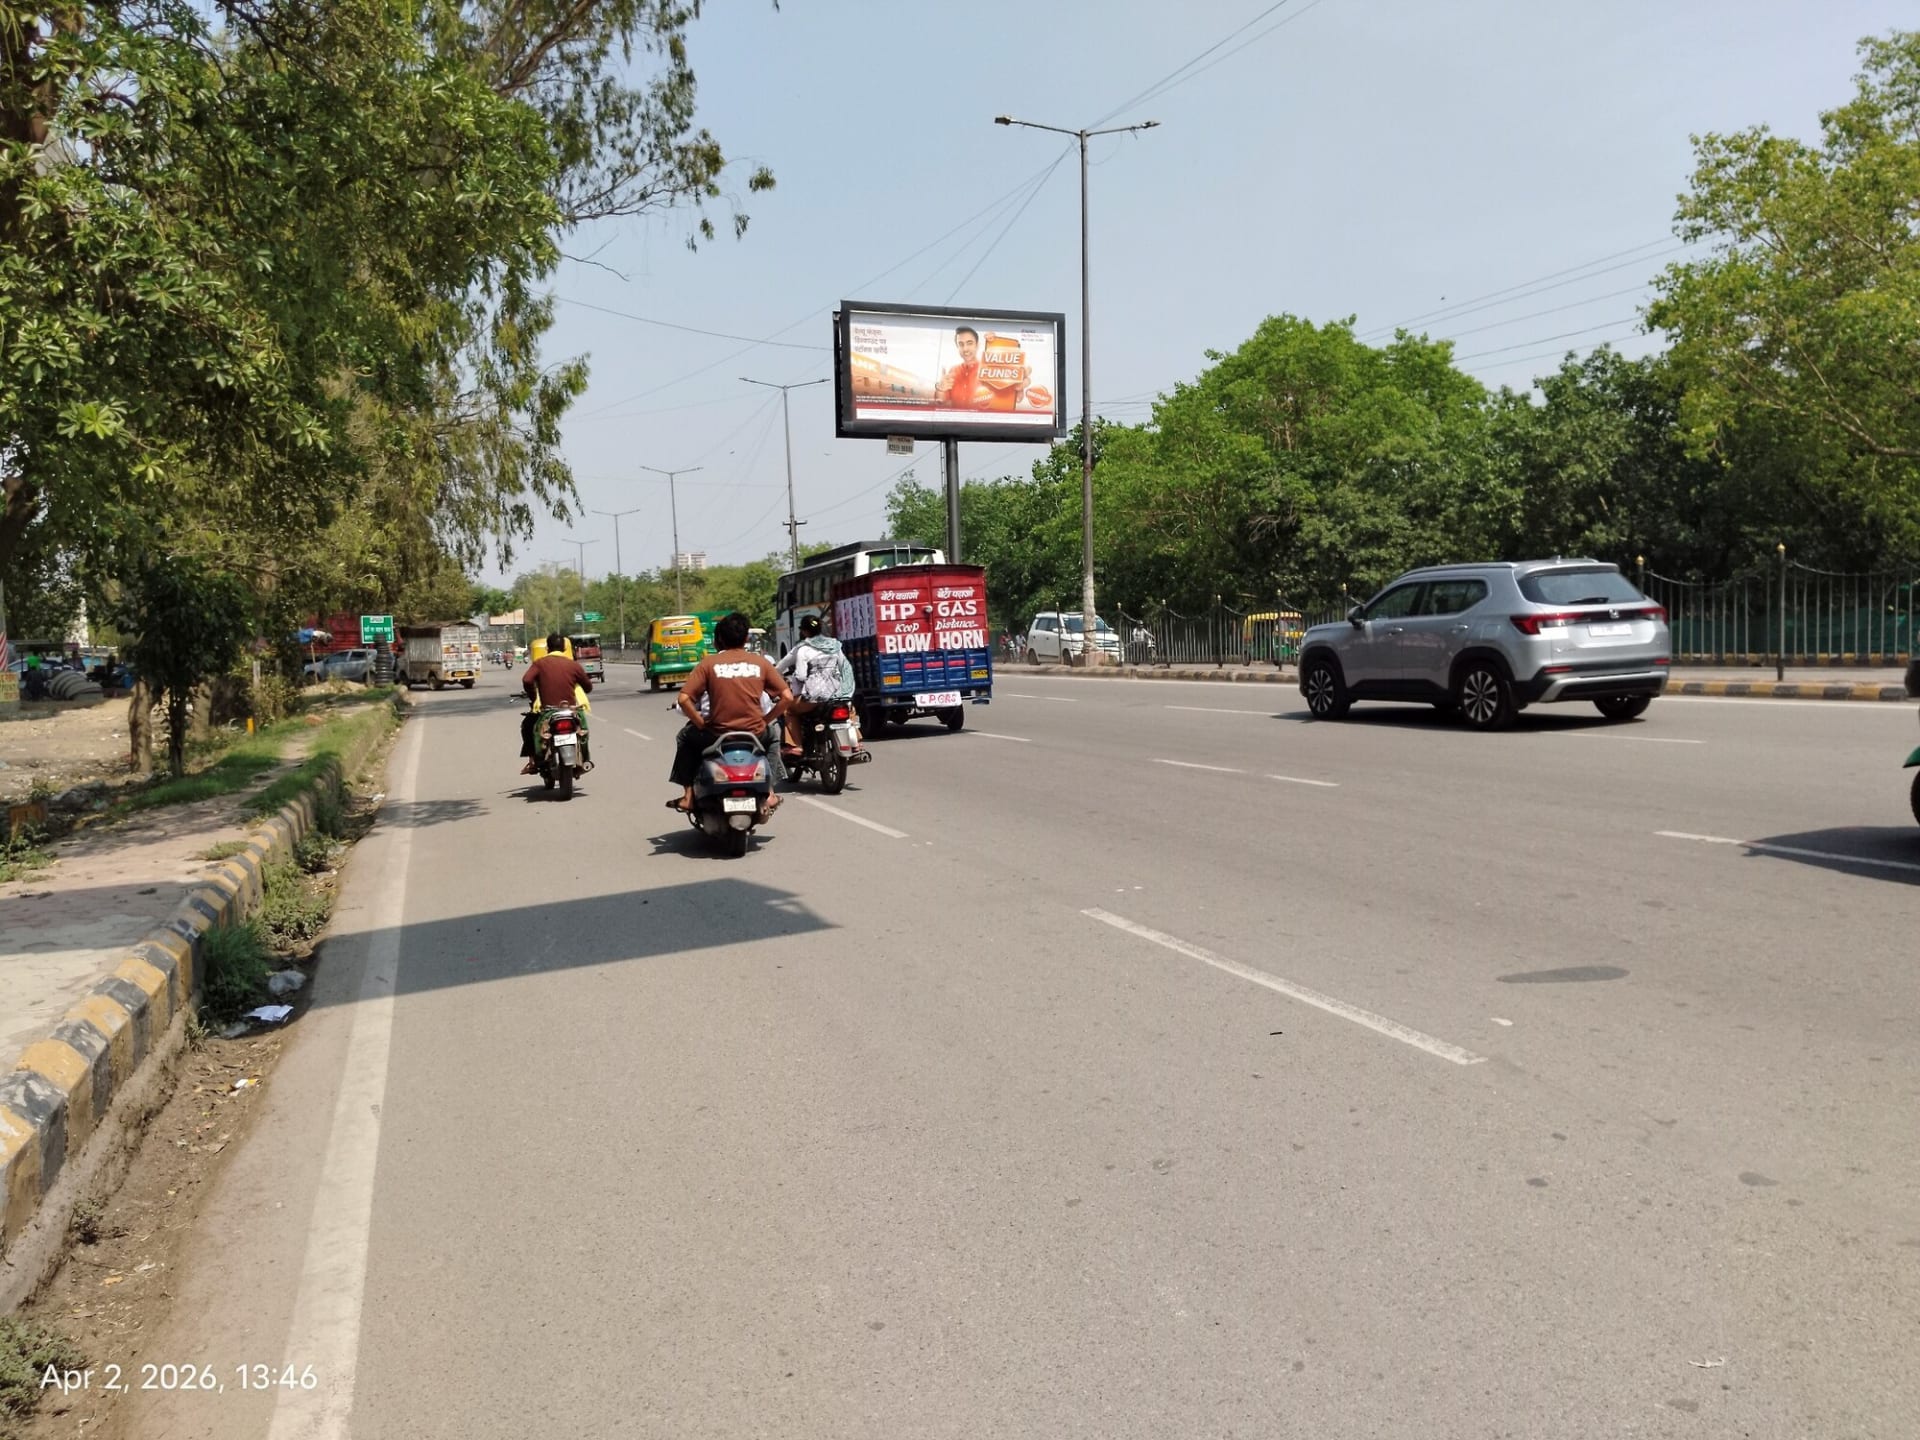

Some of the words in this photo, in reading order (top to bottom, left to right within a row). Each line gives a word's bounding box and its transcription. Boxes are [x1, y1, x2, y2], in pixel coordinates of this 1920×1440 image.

[984, 353, 1021, 364] VALUE
[979, 368, 1020, 378] FUNDS
[880, 603, 916, 620] HP
[937, 600, 977, 616] GAS
[895, 622, 920, 633] Keep
[935, 618, 979, 630] Distance
[885, 633, 931, 654] BLOW
[938, 629, 985, 649] HORN
